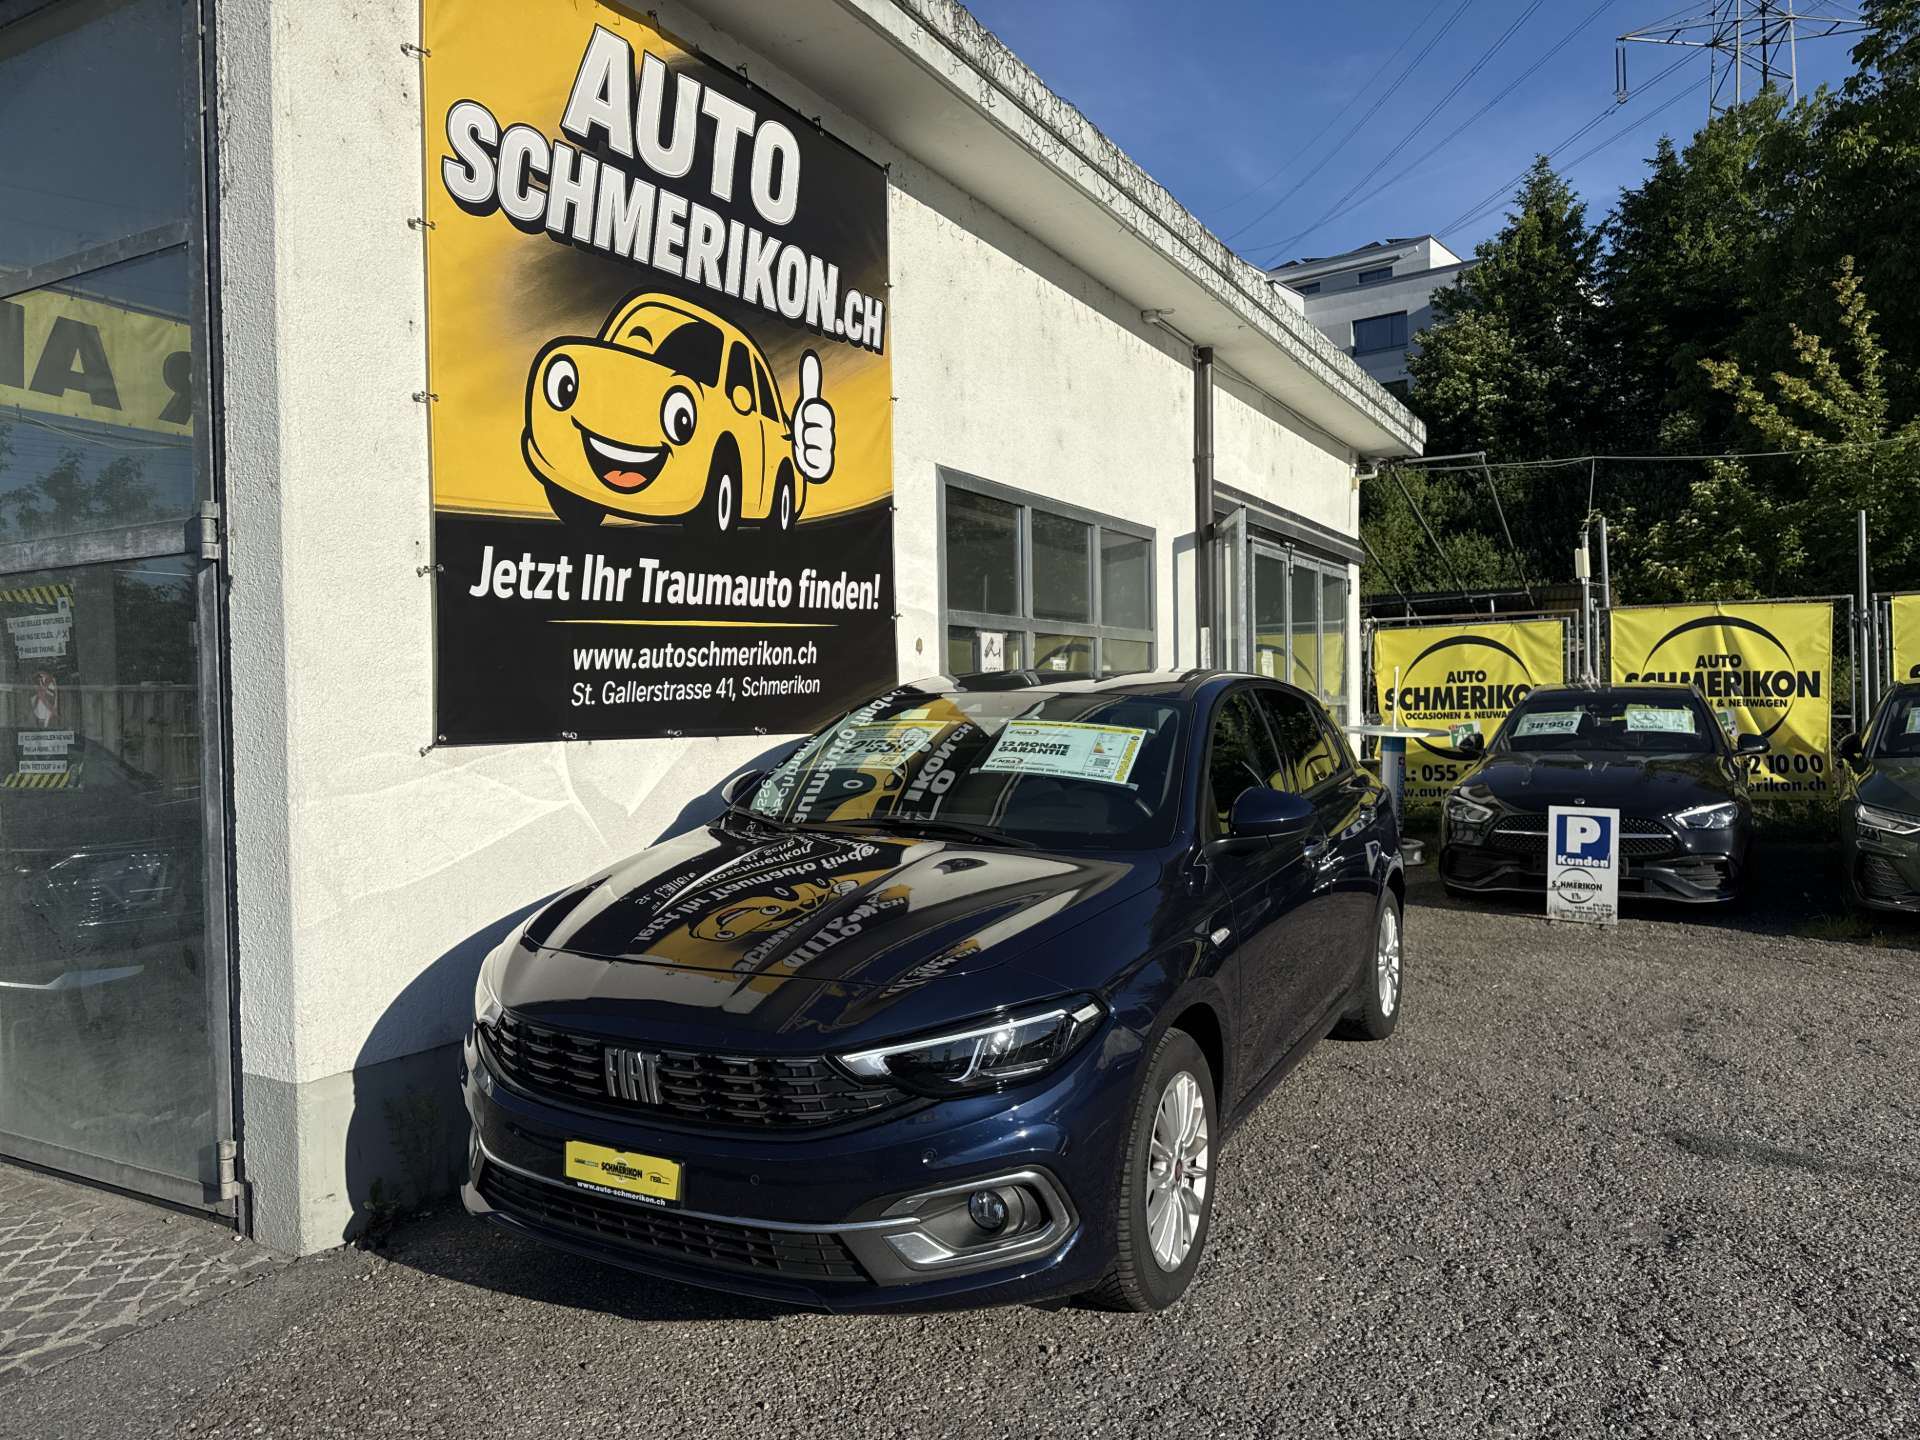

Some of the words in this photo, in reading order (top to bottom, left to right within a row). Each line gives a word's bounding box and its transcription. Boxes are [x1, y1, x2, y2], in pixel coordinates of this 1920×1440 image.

[562, 25, 800, 225] AUTO
[443, 101, 885, 348] SCHMERIKON.CH
[469, 545, 572, 600] Jetzt
[581, 553, 632, 602] Ihr
[639, 557, 792, 608] Traumauto
[799, 569, 881, 610] finden!
[573, 641, 817, 671] www.autoschmerikon.ch
[1696, 654, 1742, 669] AUTO
[1446, 670, 1487, 684] AUTO
[571, 683, 595, 706] St.
[602, 679, 712, 705] Gallerstrasse
[715, 681, 736, 702] 41,
[742, 676, 821, 697] Schmerikon
[1384, 683, 1541, 711] SCHMERIKO
[1717, 700, 1725, 708] &
[1728, 699, 1788, 708] NEUWAGEN
[1405, 711, 1461, 720] OCCASIONEN
[1463, 711, 1471, 719] &
[1474, 710, 1510, 719] NEUWA
[998, 746, 1070, 756] GARANTIE
[1017, 741, 1072, 750] MONATE
[1768, 754, 1790, 774] 10
[1794, 753, 1824, 774] 00
[1421, 764, 1459, 782] 055
[1749, 776, 1826, 793] erikon.ch
[1566, 815, 1601, 854] P
[1557, 854, 1609, 868] Kunden
[1551, 880, 1603, 892] SHMERIKON
[604, 1047, 664, 1105] FIAT
[600, 1161, 643, 1179] SCHMERIKON
[576, 1181, 666, 1207] www.auto-schmerikon.ch
